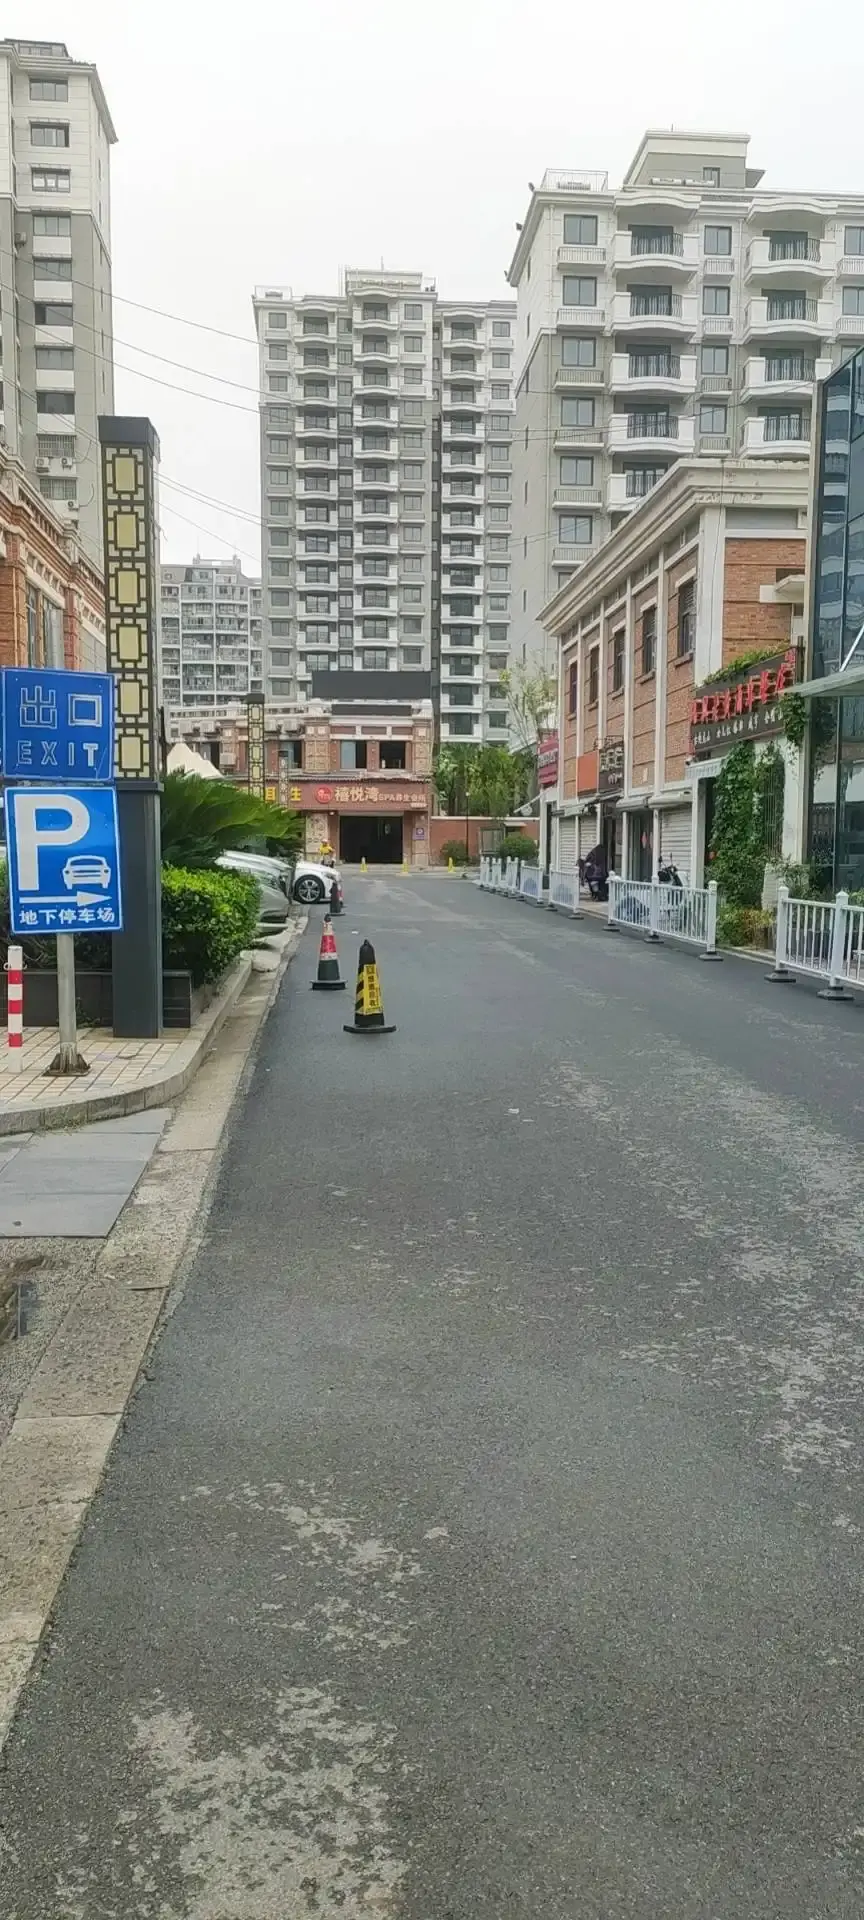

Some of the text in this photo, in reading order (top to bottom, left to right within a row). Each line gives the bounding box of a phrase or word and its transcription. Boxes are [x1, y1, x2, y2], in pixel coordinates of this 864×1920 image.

[19, 685, 103, 729] 出口
[17, 739, 99, 767] EXIT
[13, 793, 91, 891] P
[19, 907, 115, 926] 地下停车场
